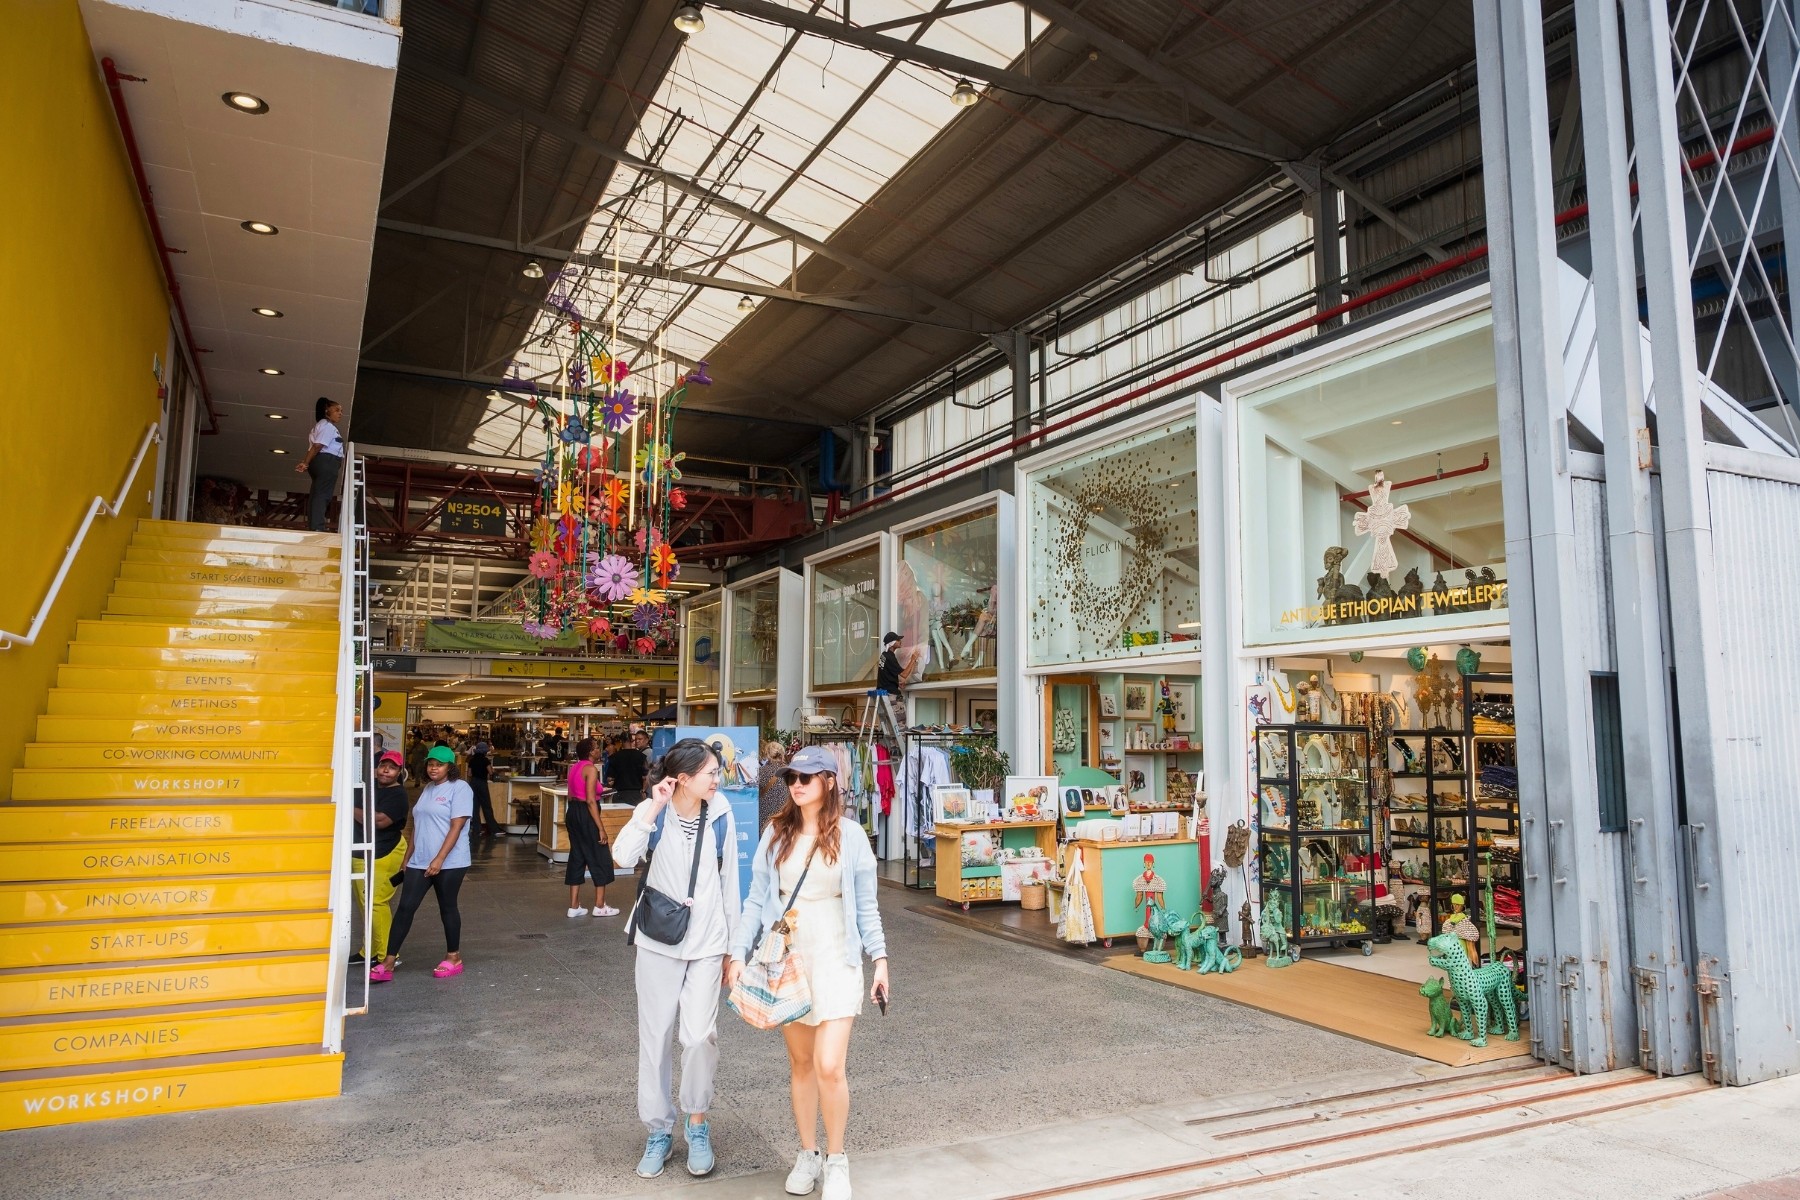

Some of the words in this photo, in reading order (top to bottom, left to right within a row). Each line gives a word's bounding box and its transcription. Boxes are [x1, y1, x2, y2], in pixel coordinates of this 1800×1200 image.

[1085, 542, 1111, 558] FLICK
[1114, 537, 1130, 550] INC
[190, 572, 220, 581] START
[223, 574, 285, 585] SOMETHING
[857, 579, 875, 594] STUDIO
[1280, 603, 1337, 625] ANTIQUE
[1340, 594, 1416, 619] ETHIOPIAN
[1420, 582, 1506, 610] JEWELLERY
[185, 676, 232, 686] EVENTS
[171, 698, 238, 709] MEETINGS
[156, 725, 242, 735] WORKSHOPS
[103, 749, 196, 760] CO-WORKING
[199, 749, 280, 761] COMMUNITY
[134, 779, 241, 790] WORKSHOP17
[109, 816, 222, 830] FREELANCERS
[83, 851, 231, 869] ORGANISATIONS
[86, 889, 209, 907] INNOVATORS
[90, 931, 189, 951] START-UPS
[49, 975, 210, 1001] ENTREPRENEURS
[53, 1028, 180, 1053] COMPANIES
[24, 1083, 188, 1115] WORKSHOP17
